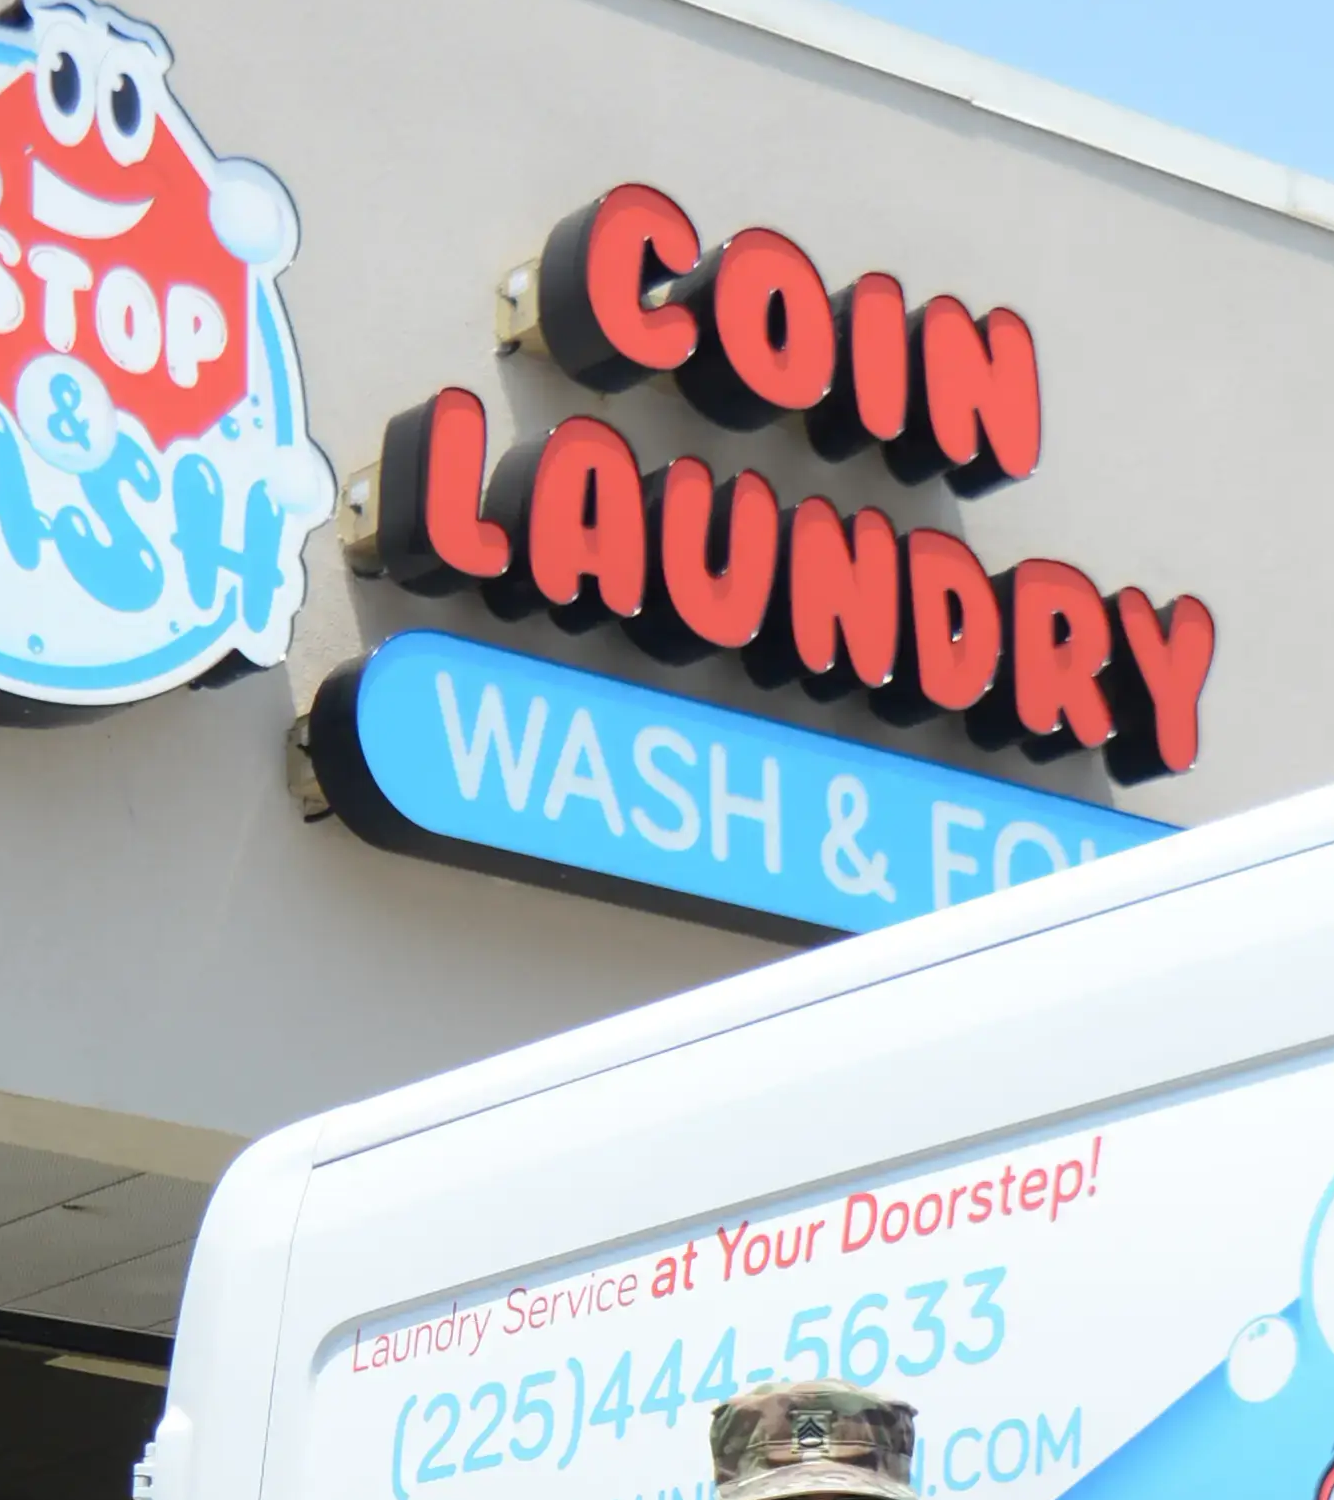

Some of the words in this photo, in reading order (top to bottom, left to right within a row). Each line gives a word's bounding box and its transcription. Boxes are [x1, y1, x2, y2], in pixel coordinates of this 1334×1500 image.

[46, 372, 93, 452] &
[588, 183, 1041, 481] COIN
[426, 387, 1215, 773] LAUNDRY
[435, 670, 782, 874] WASH
[821, 773, 897, 904] &
[931, 800, 1097, 912] FO
[351, 1302, 490, 1373] Laundry
[502, 1272, 638, 1335] Service
[649, 1239, 698, 1299] at
[717, 1218, 826, 1281] Your
[841, 1135, 1103, 1254] Doorstep!
